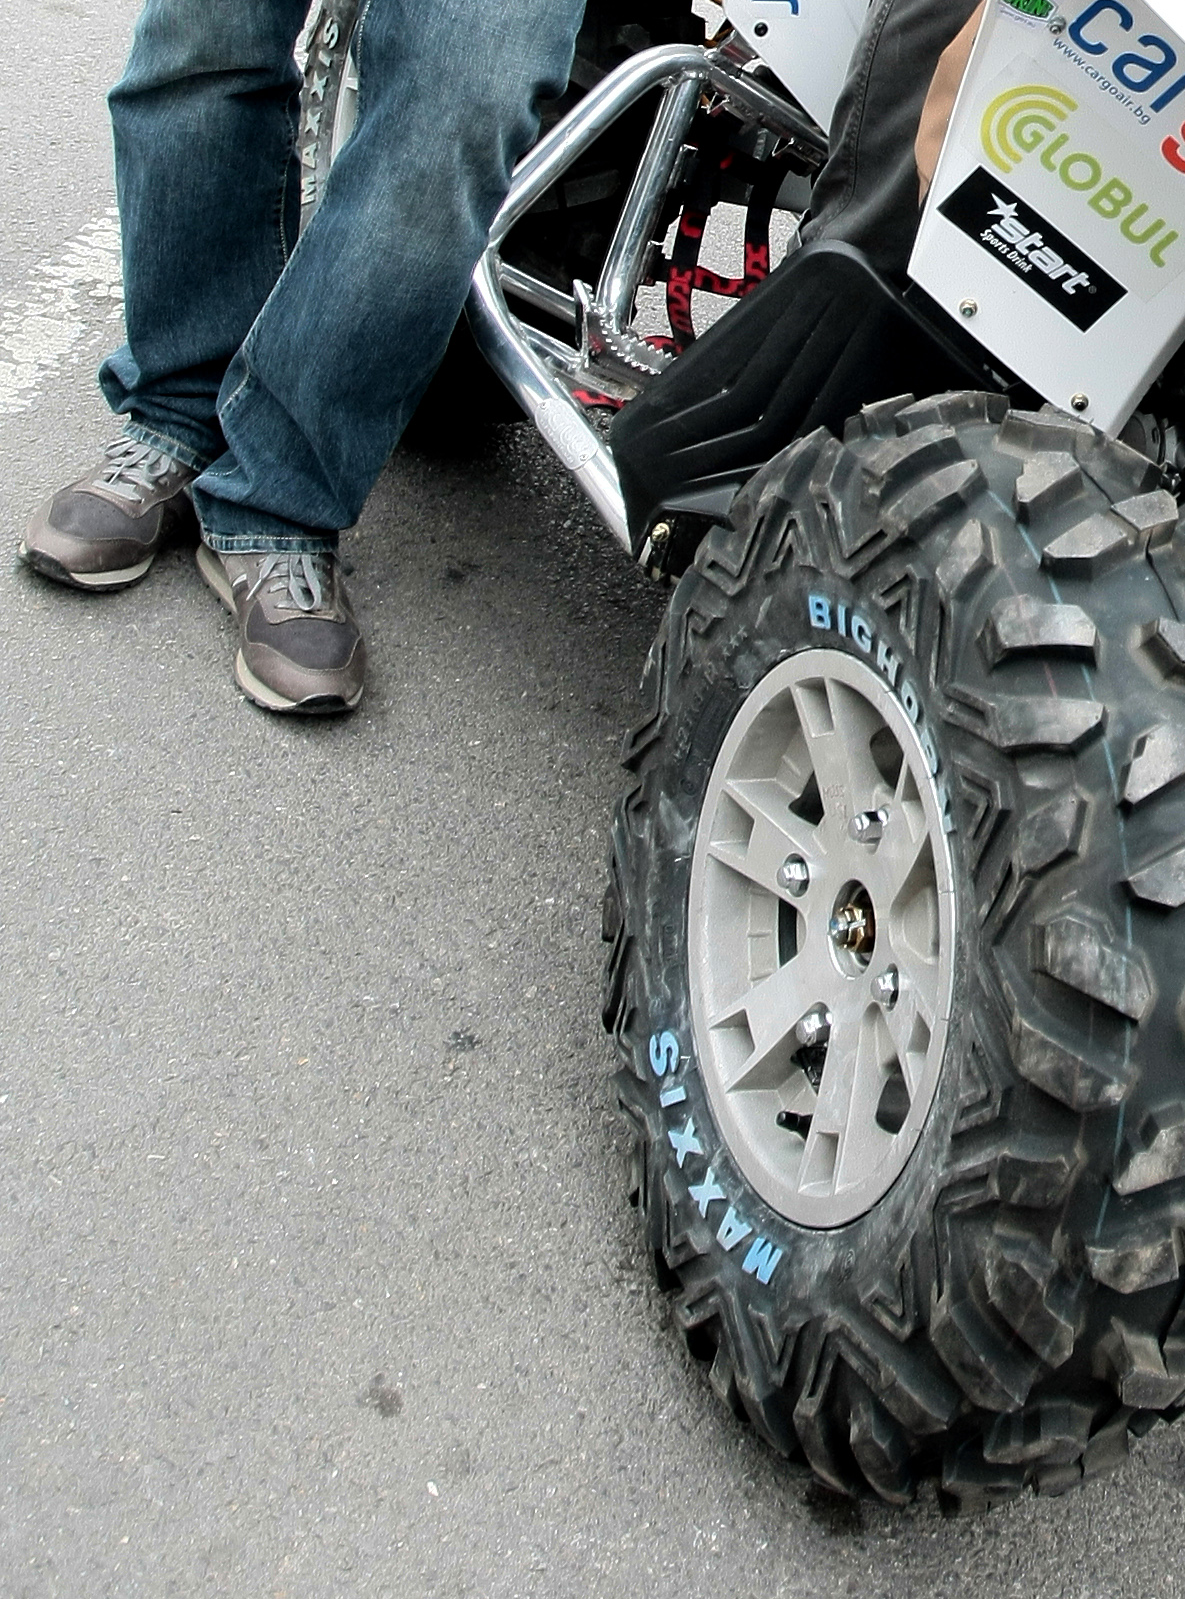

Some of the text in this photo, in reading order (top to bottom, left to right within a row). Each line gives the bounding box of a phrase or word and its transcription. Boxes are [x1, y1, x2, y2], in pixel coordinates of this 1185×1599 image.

[1053, 38, 1151, 125] www.cargoair.bg
[1012, 114, 1180, 269] GLOBUL
[980, 229, 1033, 273] Sports Drink
[991, 217, 1091, 295] start
[649, 1029, 784, 1286] MAXXIS
